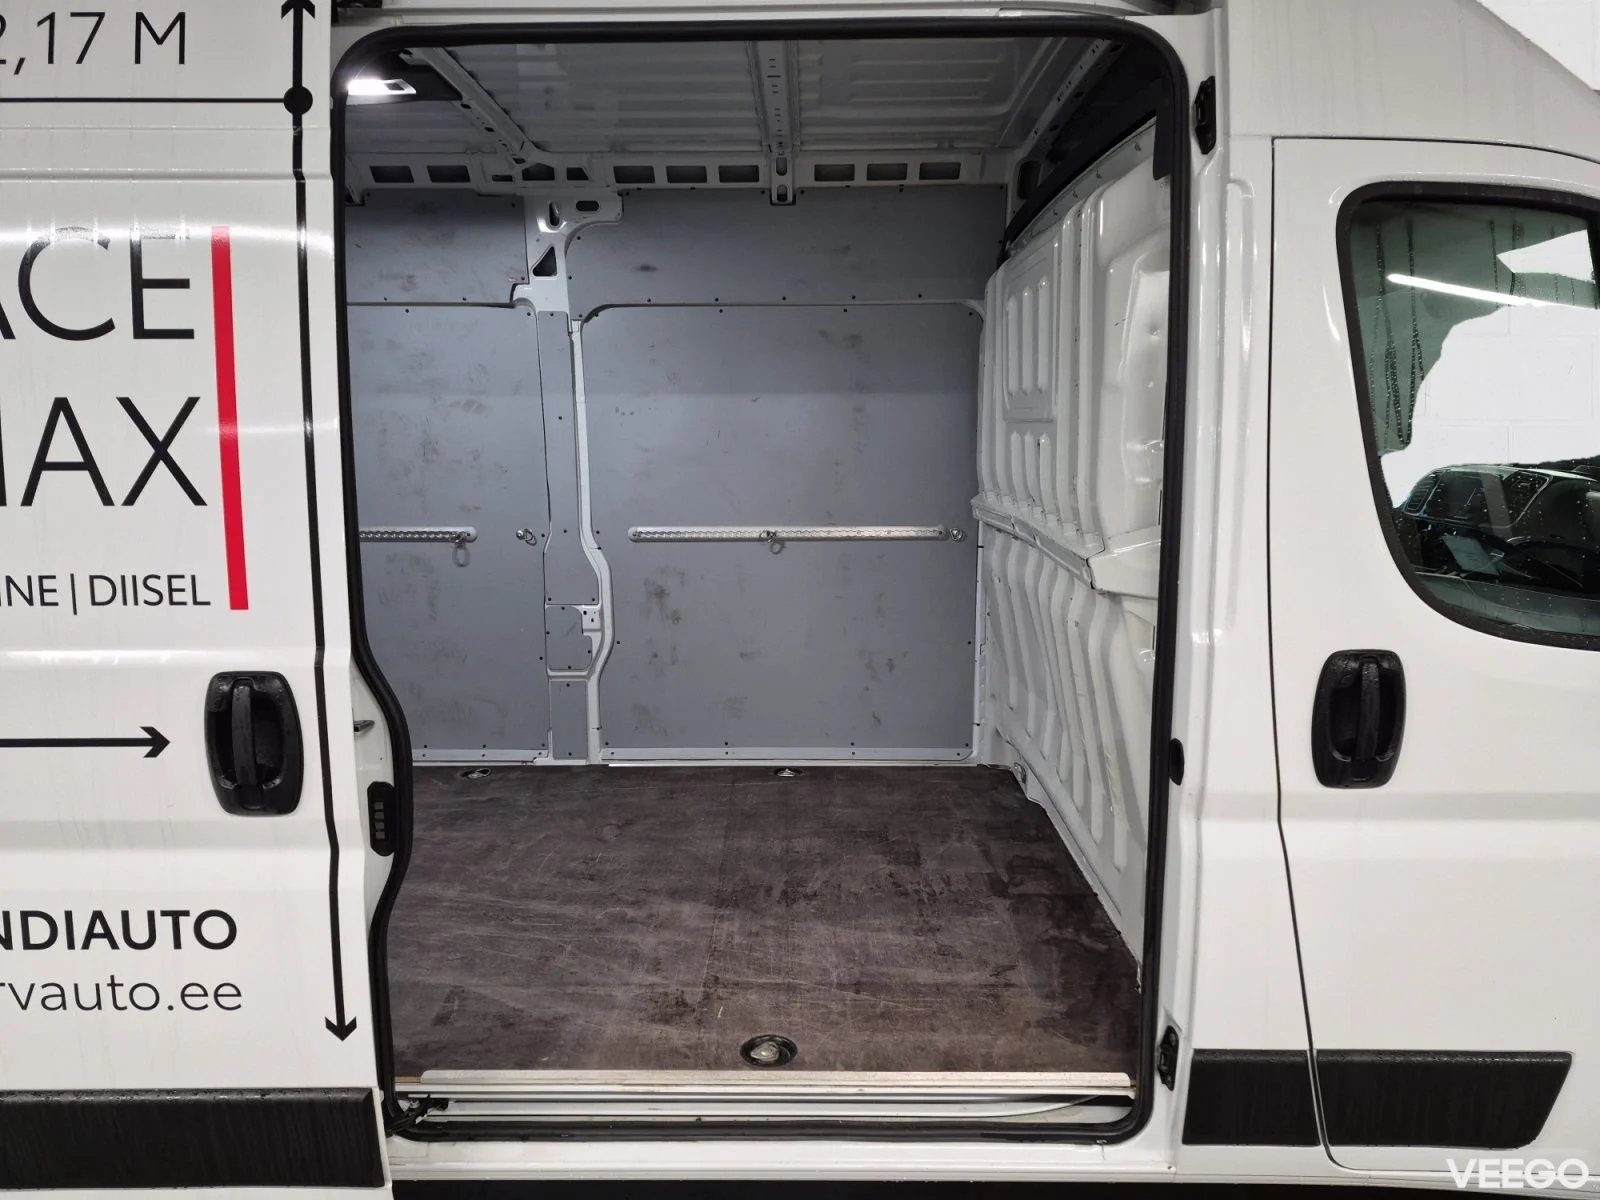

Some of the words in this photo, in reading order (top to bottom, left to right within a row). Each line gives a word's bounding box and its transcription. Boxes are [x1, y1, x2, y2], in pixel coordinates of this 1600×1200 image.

[0, 12, 105, 75] ,17
[134, 12, 186, 65] M
[0, 226, 195, 341] CE
[0, 396, 208, 507] AX
[0, 575, 59, 607] NE
[0, 974, 242, 1011] vauto.ee
